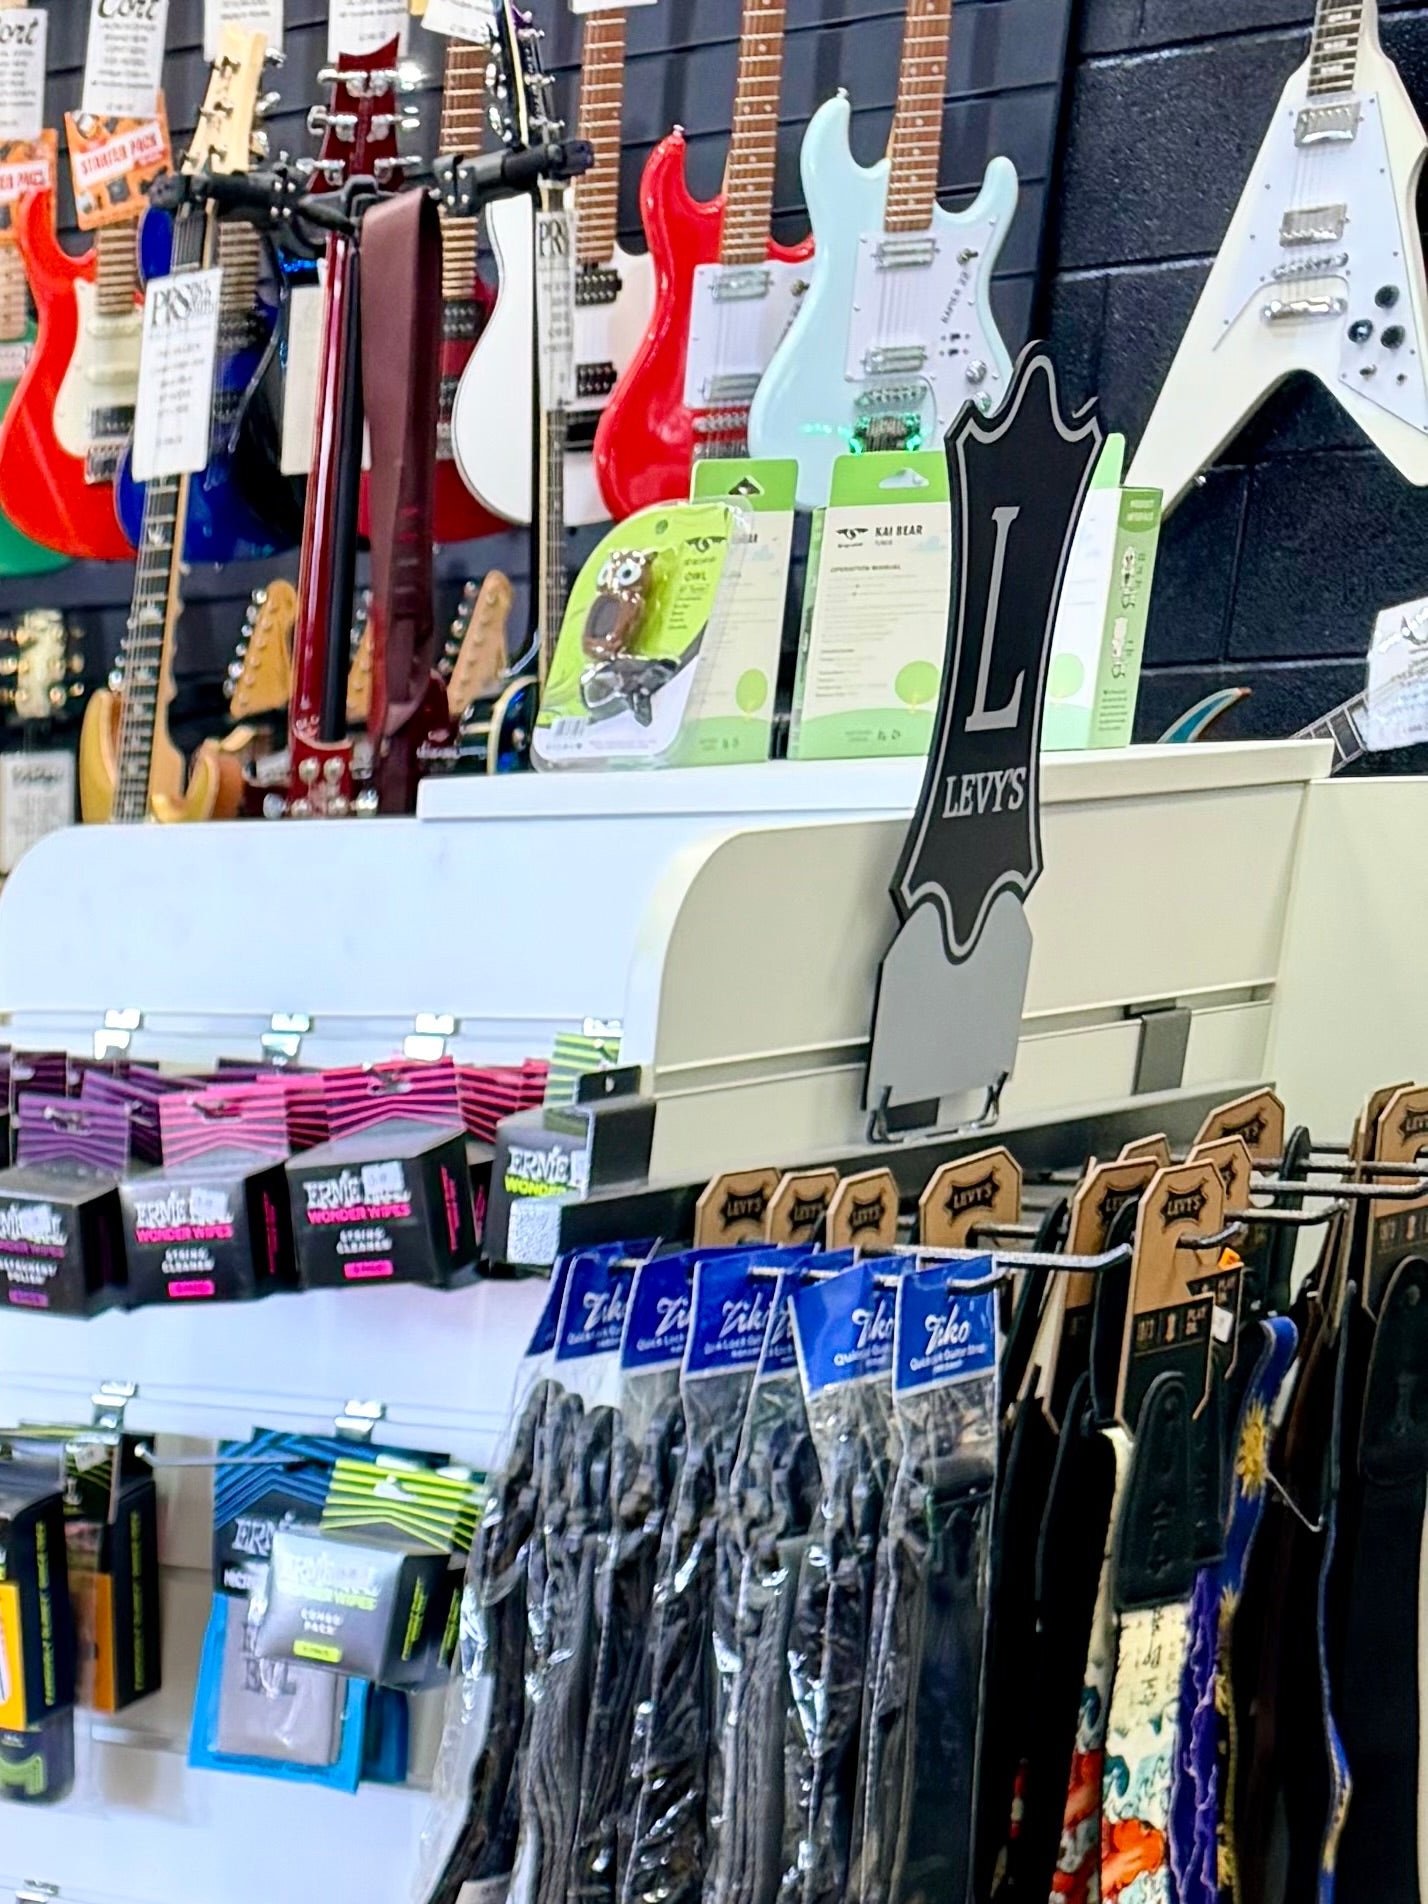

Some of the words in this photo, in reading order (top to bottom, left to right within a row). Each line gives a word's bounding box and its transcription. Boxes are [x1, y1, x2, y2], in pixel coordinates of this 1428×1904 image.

[895, 525, 924, 537] BEAR
[965, 505, 1026, 733] L
[943, 766, 1027, 820] LEVY'S
[507, 1144, 572, 1180] ERNIE
[302, 1169, 363, 1210] ERNIE
[306, 1206, 368, 1225] WONDER
[369, 1202, 412, 1219] WIPES
[135, 1227, 192, 1244] WONDER
[193, 1224, 234, 1240] WIPES
